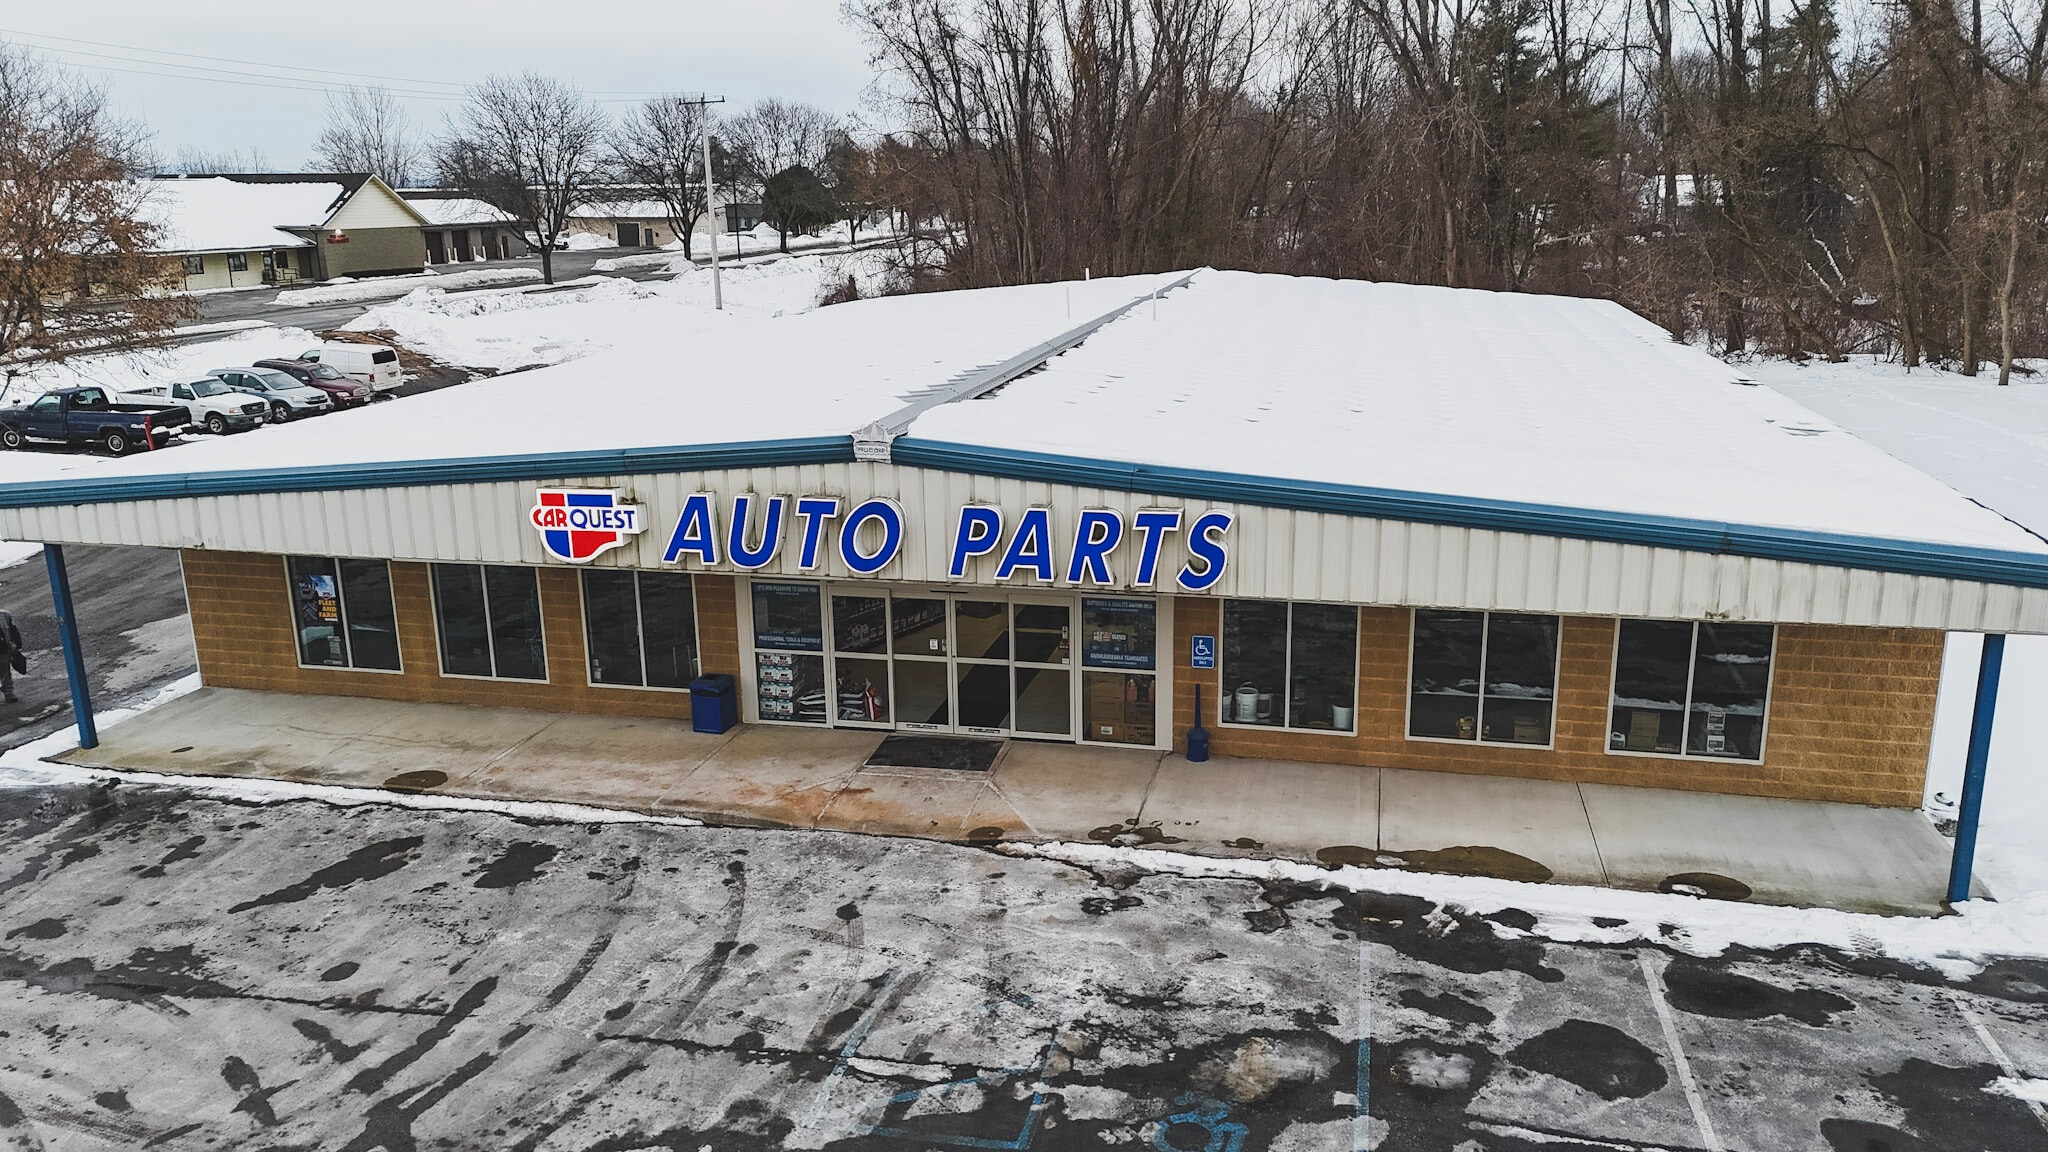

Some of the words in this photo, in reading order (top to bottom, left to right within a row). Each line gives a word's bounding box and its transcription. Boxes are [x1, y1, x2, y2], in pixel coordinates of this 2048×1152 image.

[661, 493, 905, 574] AUTO
[948, 504, 1236, 591] PARTS
[758, 635, 785, 643] PROFESSIONAL
